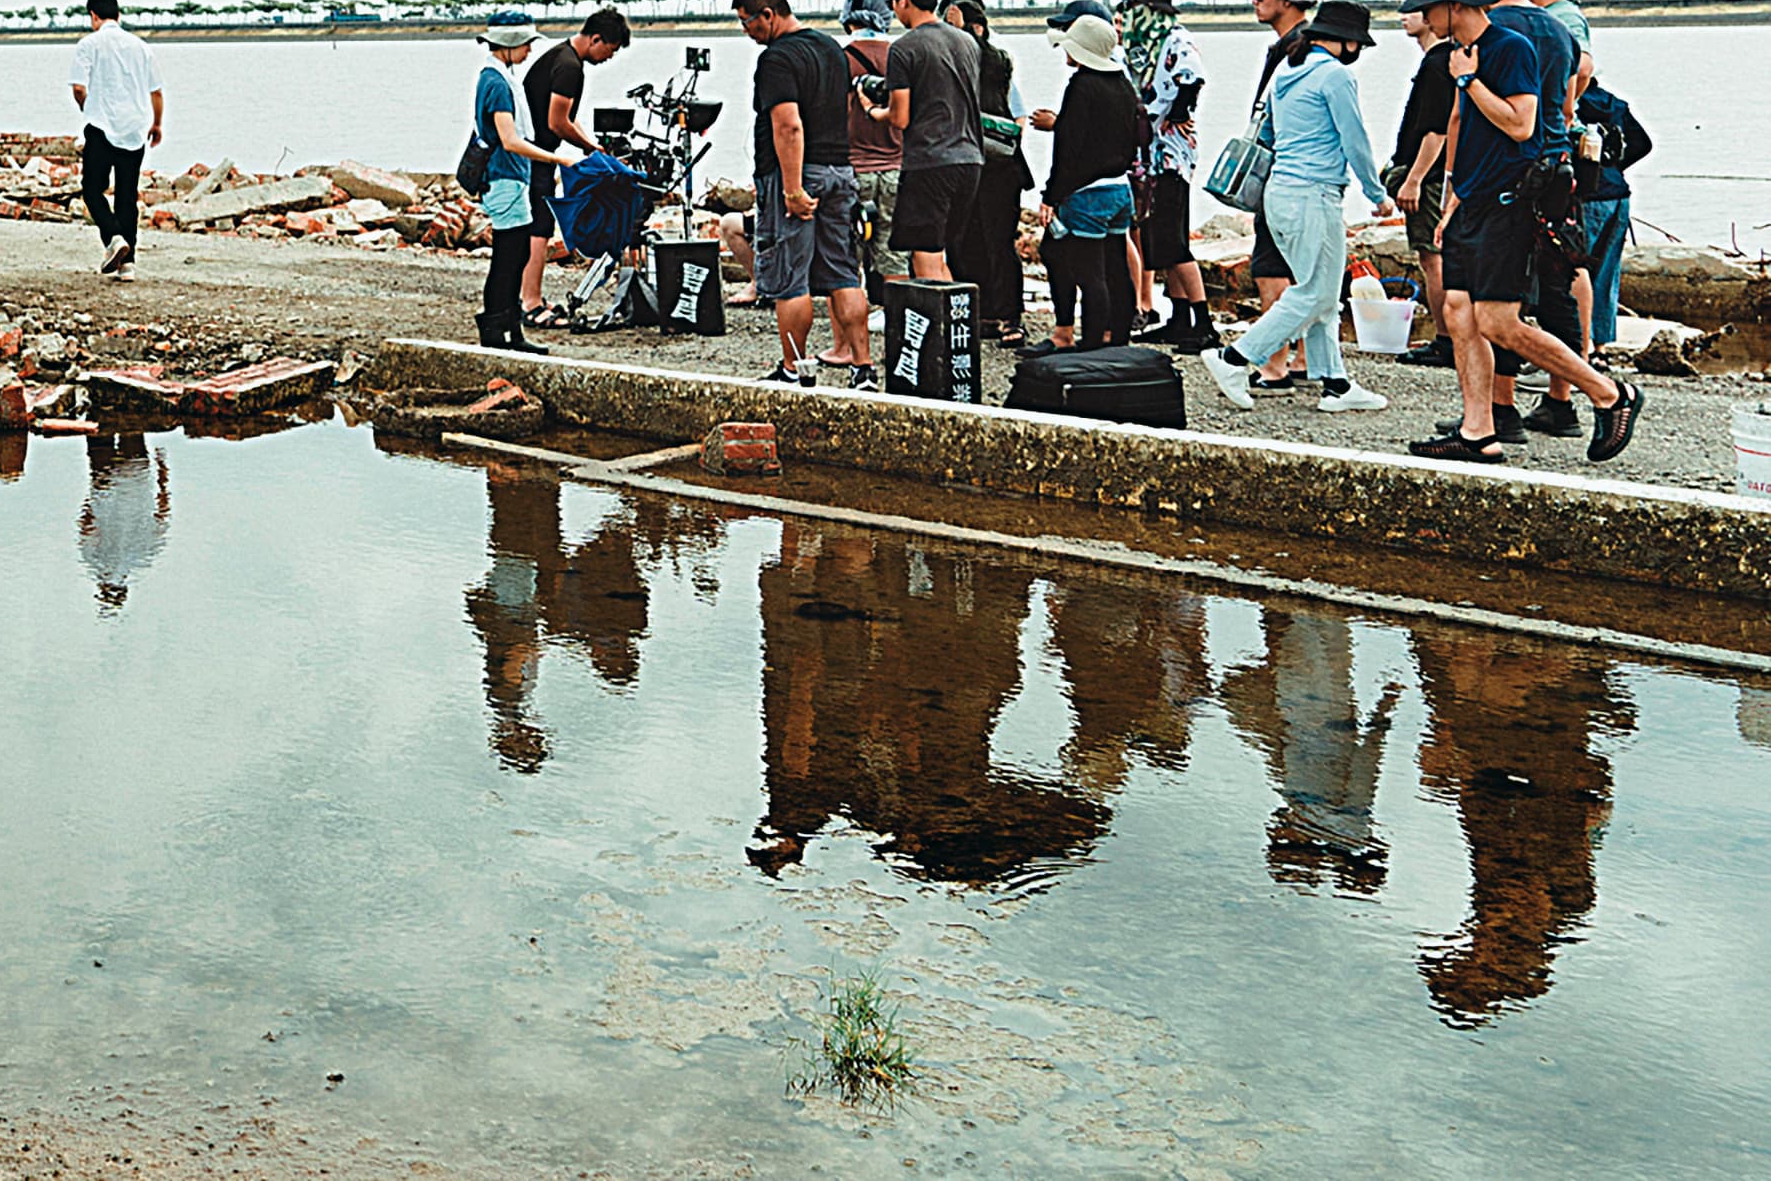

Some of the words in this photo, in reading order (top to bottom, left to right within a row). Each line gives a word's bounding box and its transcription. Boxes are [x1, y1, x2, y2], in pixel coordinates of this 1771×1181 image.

[682, 262, 710, 294] GRIP
[904, 308, 930, 349] GRIP
[893, 346, 920, 386] TRIX
